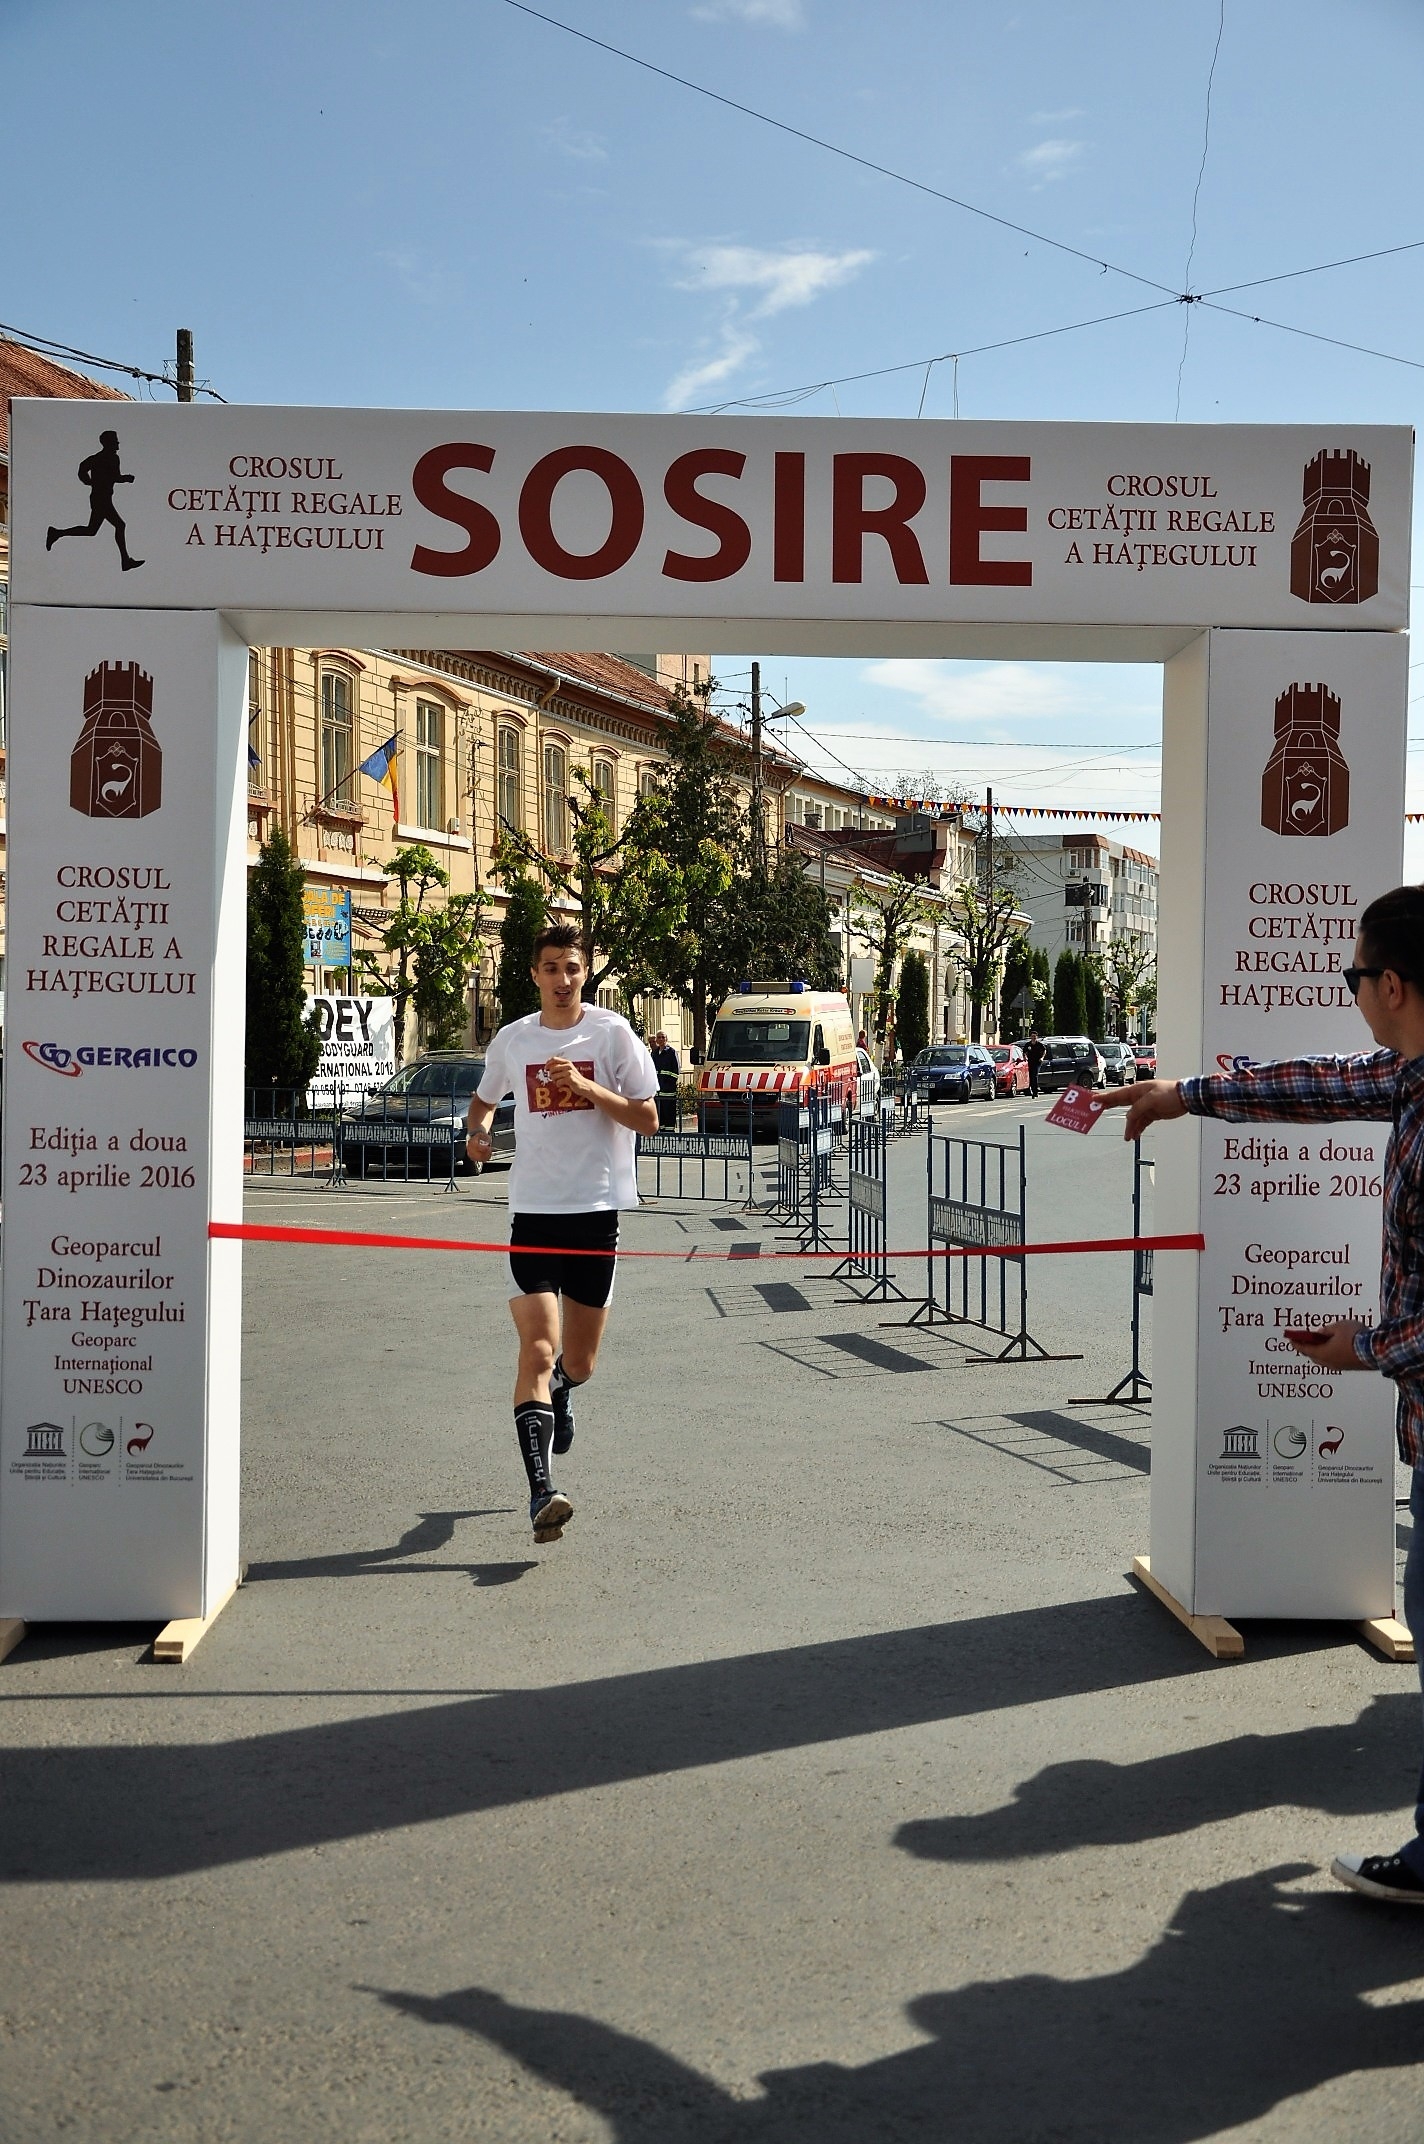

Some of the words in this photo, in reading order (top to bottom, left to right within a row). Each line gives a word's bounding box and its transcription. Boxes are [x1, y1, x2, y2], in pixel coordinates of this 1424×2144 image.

[229, 456, 342, 479] CROSUL
[1108, 475, 1217, 497] CROSUL
[291, 493, 402, 515] REGALE
[410, 443, 1032, 586] SOSIRE
[1167, 510, 1275, 532] REGALE
[186, 523, 205, 545] A
[1065, 542, 1083, 563] A
[57, 866, 170, 889] CROSUL
[1249, 884, 1357, 905] CROSUL
[42, 936, 154, 958] REGALE
[163, 937, 182, 959] A
[1235, 951, 1341, 973] REGALE
[76, 1046, 198, 1068] GERAICO
[716, 1064, 731, 1072] 112
[374, 1061, 394, 1076] 2012
[535, 1087, 551, 1109] B
[1063, 1089, 1079, 1104] B
[1051, 1113, 1080, 1129] LOCUL
[108, 1136, 119, 1150] a
[130, 1128, 187, 1151] doua
[1299, 1147, 1309, 1160] a
[1320, 1139, 1374, 1161] doua
[19, 1164, 47, 1185] 23
[58, 1164, 130, 1193] aprilie
[140, 1166, 195, 1188] 2016
[1214, 1174, 1240, 1195] 23
[1251, 1173, 1320, 1202] aprilie
[1329, 1174, 1383, 1197] 2016
[52, 1236, 160, 1262] Geoparcul
[1245, 1244, 1349, 1269] Geoparcul
[37, 1268, 174, 1289] Dinozaurilor
[1232, 1275, 1362, 1295] Dinozaurilor
[72, 1332, 136, 1351] Geoparc
[64, 1379, 142, 1394] UNESCO
[1258, 1384, 1333, 1398] UNESCO
